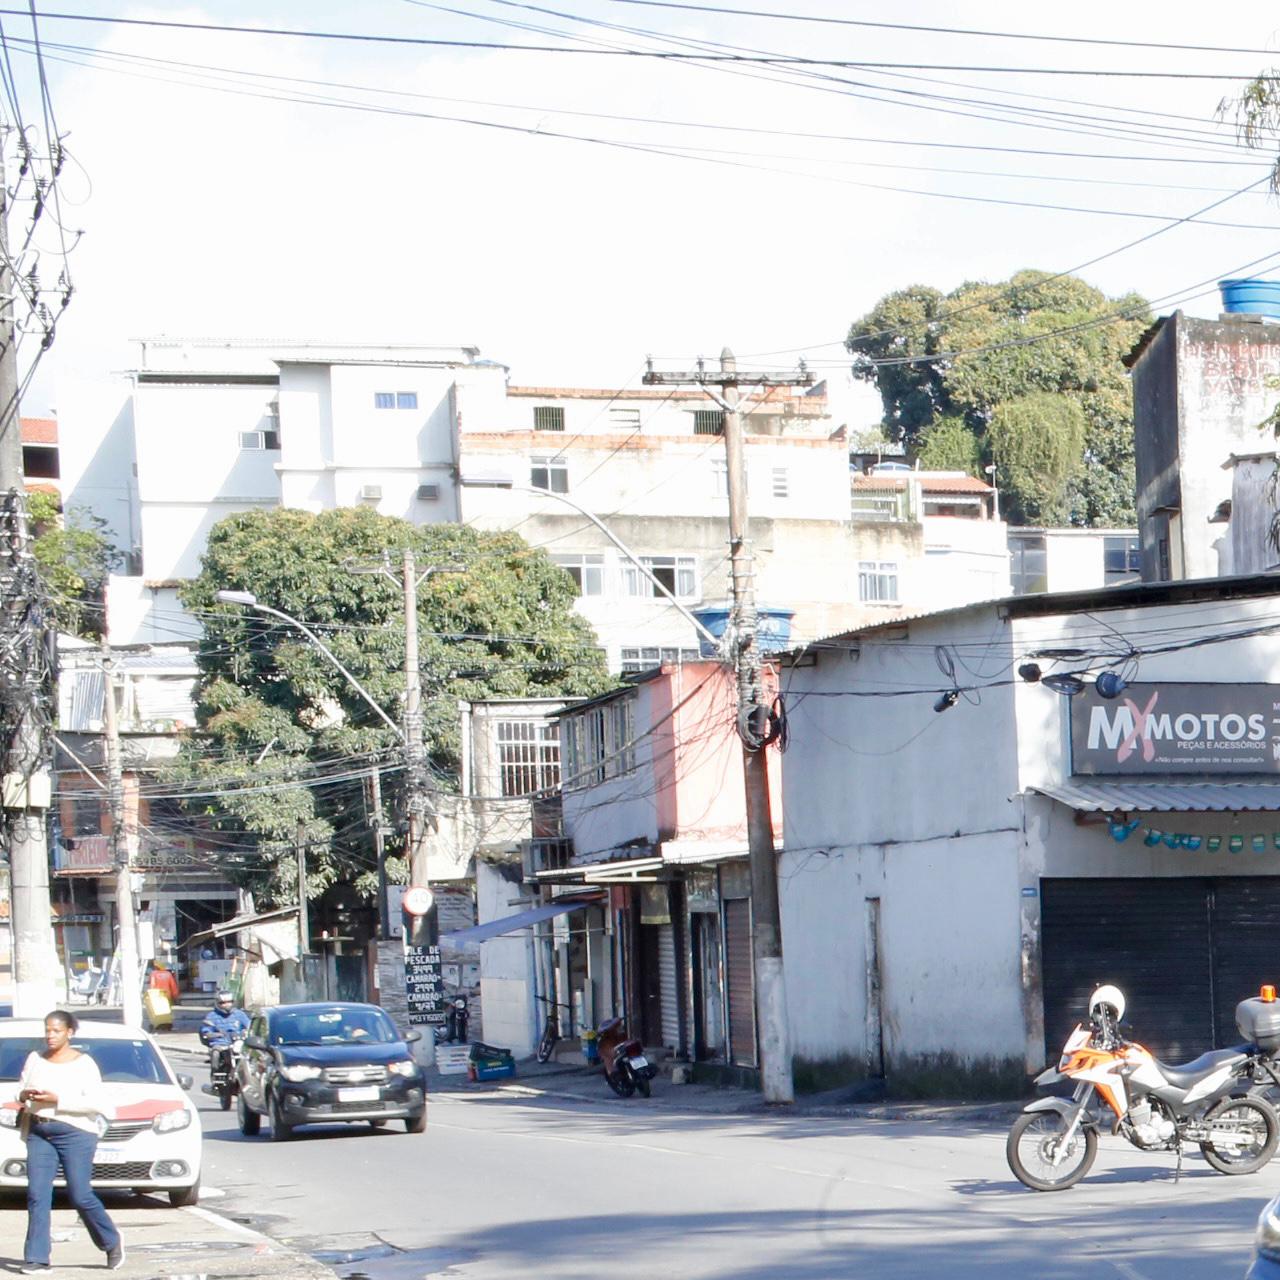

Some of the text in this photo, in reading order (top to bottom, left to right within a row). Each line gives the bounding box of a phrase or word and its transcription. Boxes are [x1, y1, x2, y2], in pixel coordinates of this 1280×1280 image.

[1143, 713, 1266, 741] MOTOS
[1177, 741, 1204, 750] PEÇAS
[1206, 741, 1213, 749] E
[1214, 739, 1266, 750] ACESSÓRIOS
[429, 946, 440, 954] DE
[405, 955, 440, 964] PESCADA
